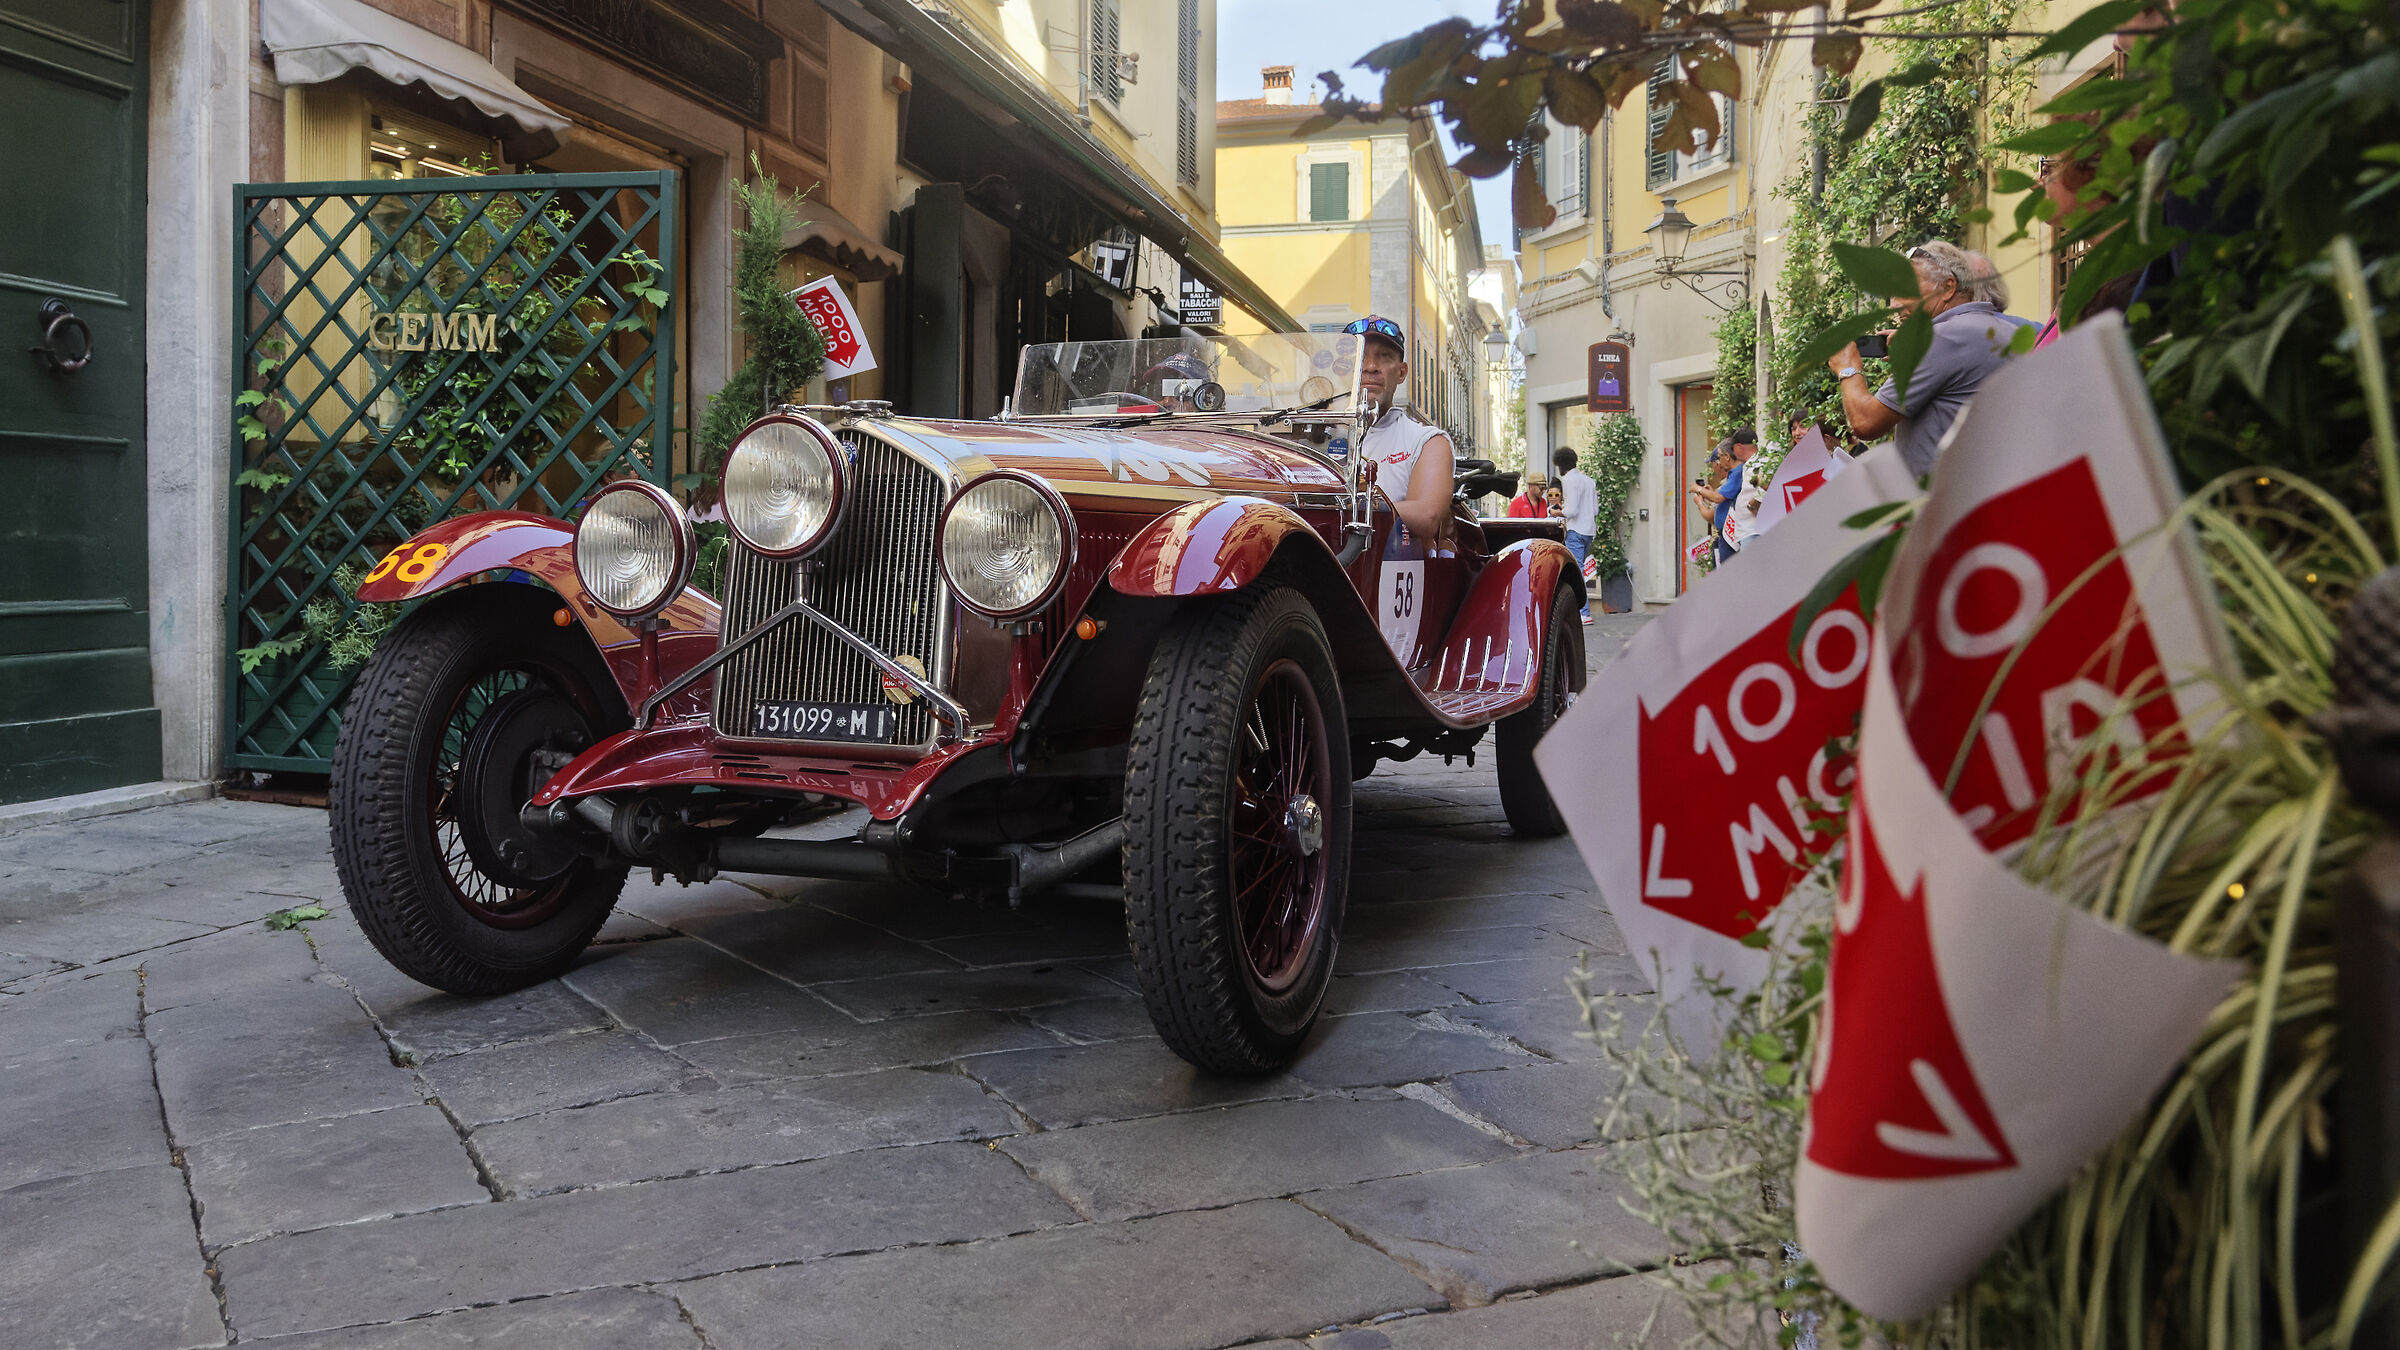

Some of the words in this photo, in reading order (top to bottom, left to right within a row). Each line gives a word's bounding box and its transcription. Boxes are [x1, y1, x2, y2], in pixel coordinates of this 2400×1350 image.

[798, 298, 838, 352] MIGLIA
[818, 295, 851, 344] 1000
[1180, 297, 1220, 308] TABACCHI
[369, 312, 517, 353] GEMM
[1598, 354, 1620, 363] LINEA
[364, 542, 449, 584] 58
[1394, 571, 1414, 619] 58
[1693, 608, 1871, 776] 100
[758, 705, 833, 733] 131099
[1729, 734, 1857, 901] MIG
